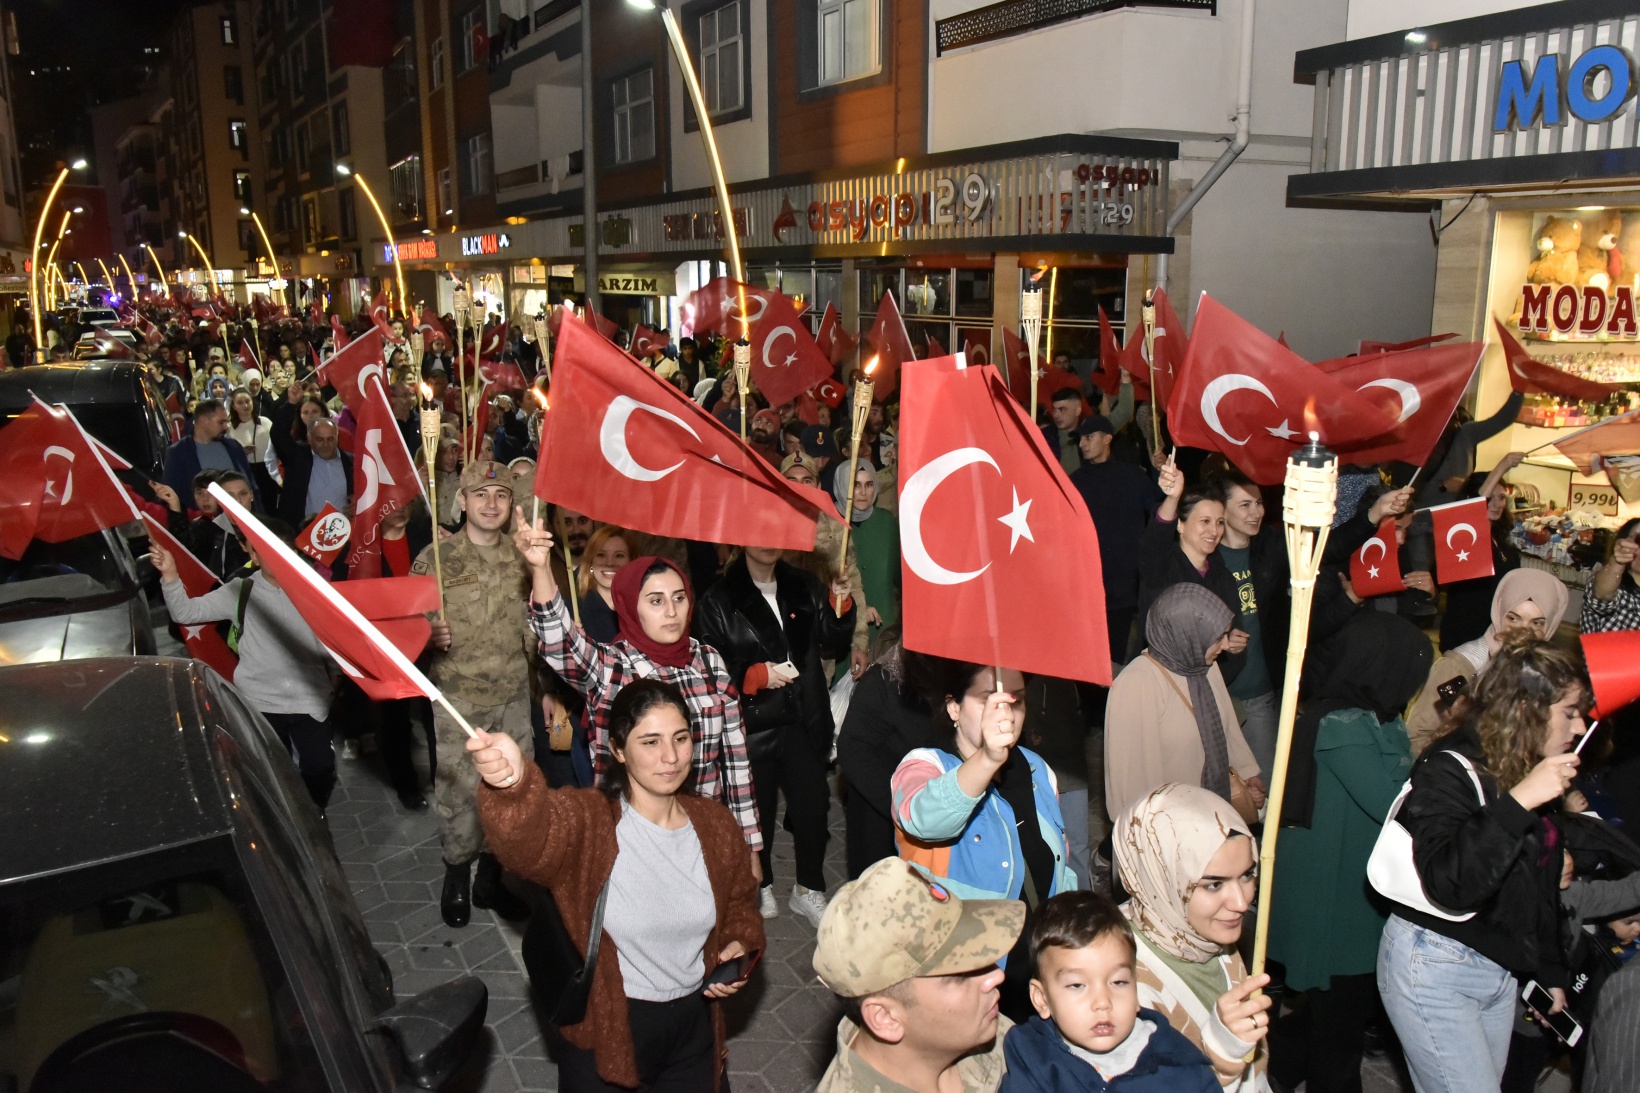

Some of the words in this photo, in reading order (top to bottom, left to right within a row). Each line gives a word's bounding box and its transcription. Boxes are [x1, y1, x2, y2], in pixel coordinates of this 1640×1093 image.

[1493, 44, 1640, 134] MO
[935, 173, 986, 225] 29
[1106, 201, 1134, 225] 29
[462, 233, 498, 256] BLACKMAN
[599, 277, 658, 292] ARZIM
[1518, 284, 1638, 336] MODA
[303, 545, 322, 560] ATA
